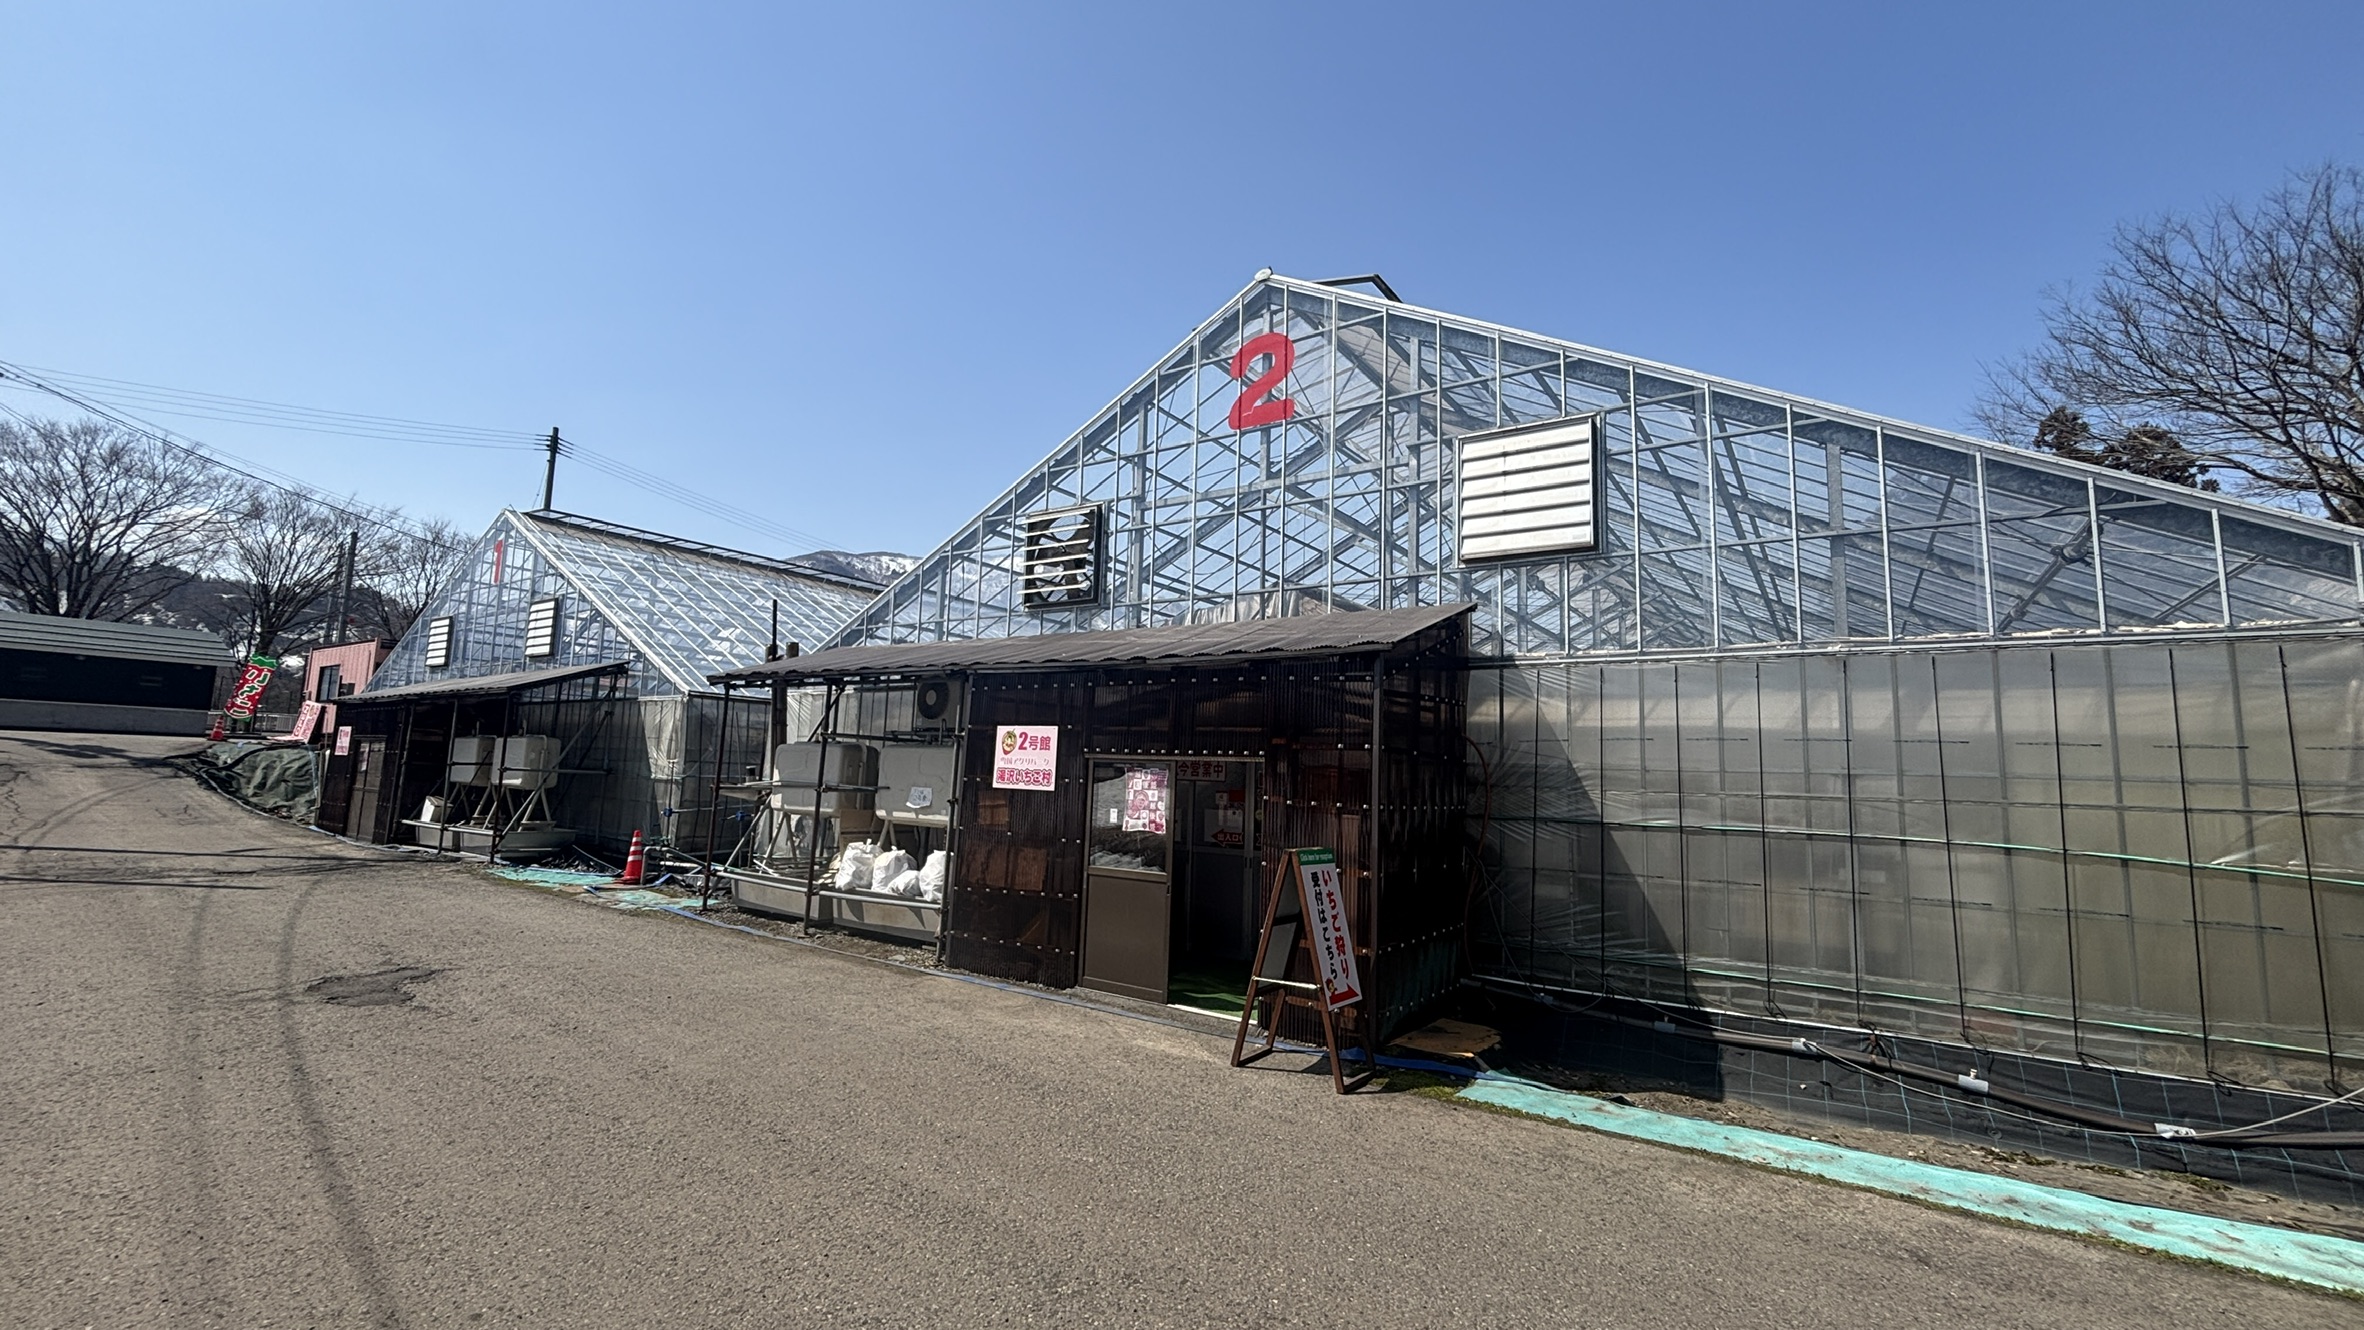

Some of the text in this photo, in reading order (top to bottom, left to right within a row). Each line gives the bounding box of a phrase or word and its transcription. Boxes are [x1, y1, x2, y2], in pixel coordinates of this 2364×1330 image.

[1228, 332, 1295, 430] 2
[494, 539, 503, 585] 1
[1018, 731, 1051, 751] 2号館
[996, 767, 1053, 787] 湯沢いちご村
[1217, 833, 1239, 842] 出入口
[1310, 871, 1338, 980] 受付はこちら
[1322, 869, 1350, 979] いちご狩り
